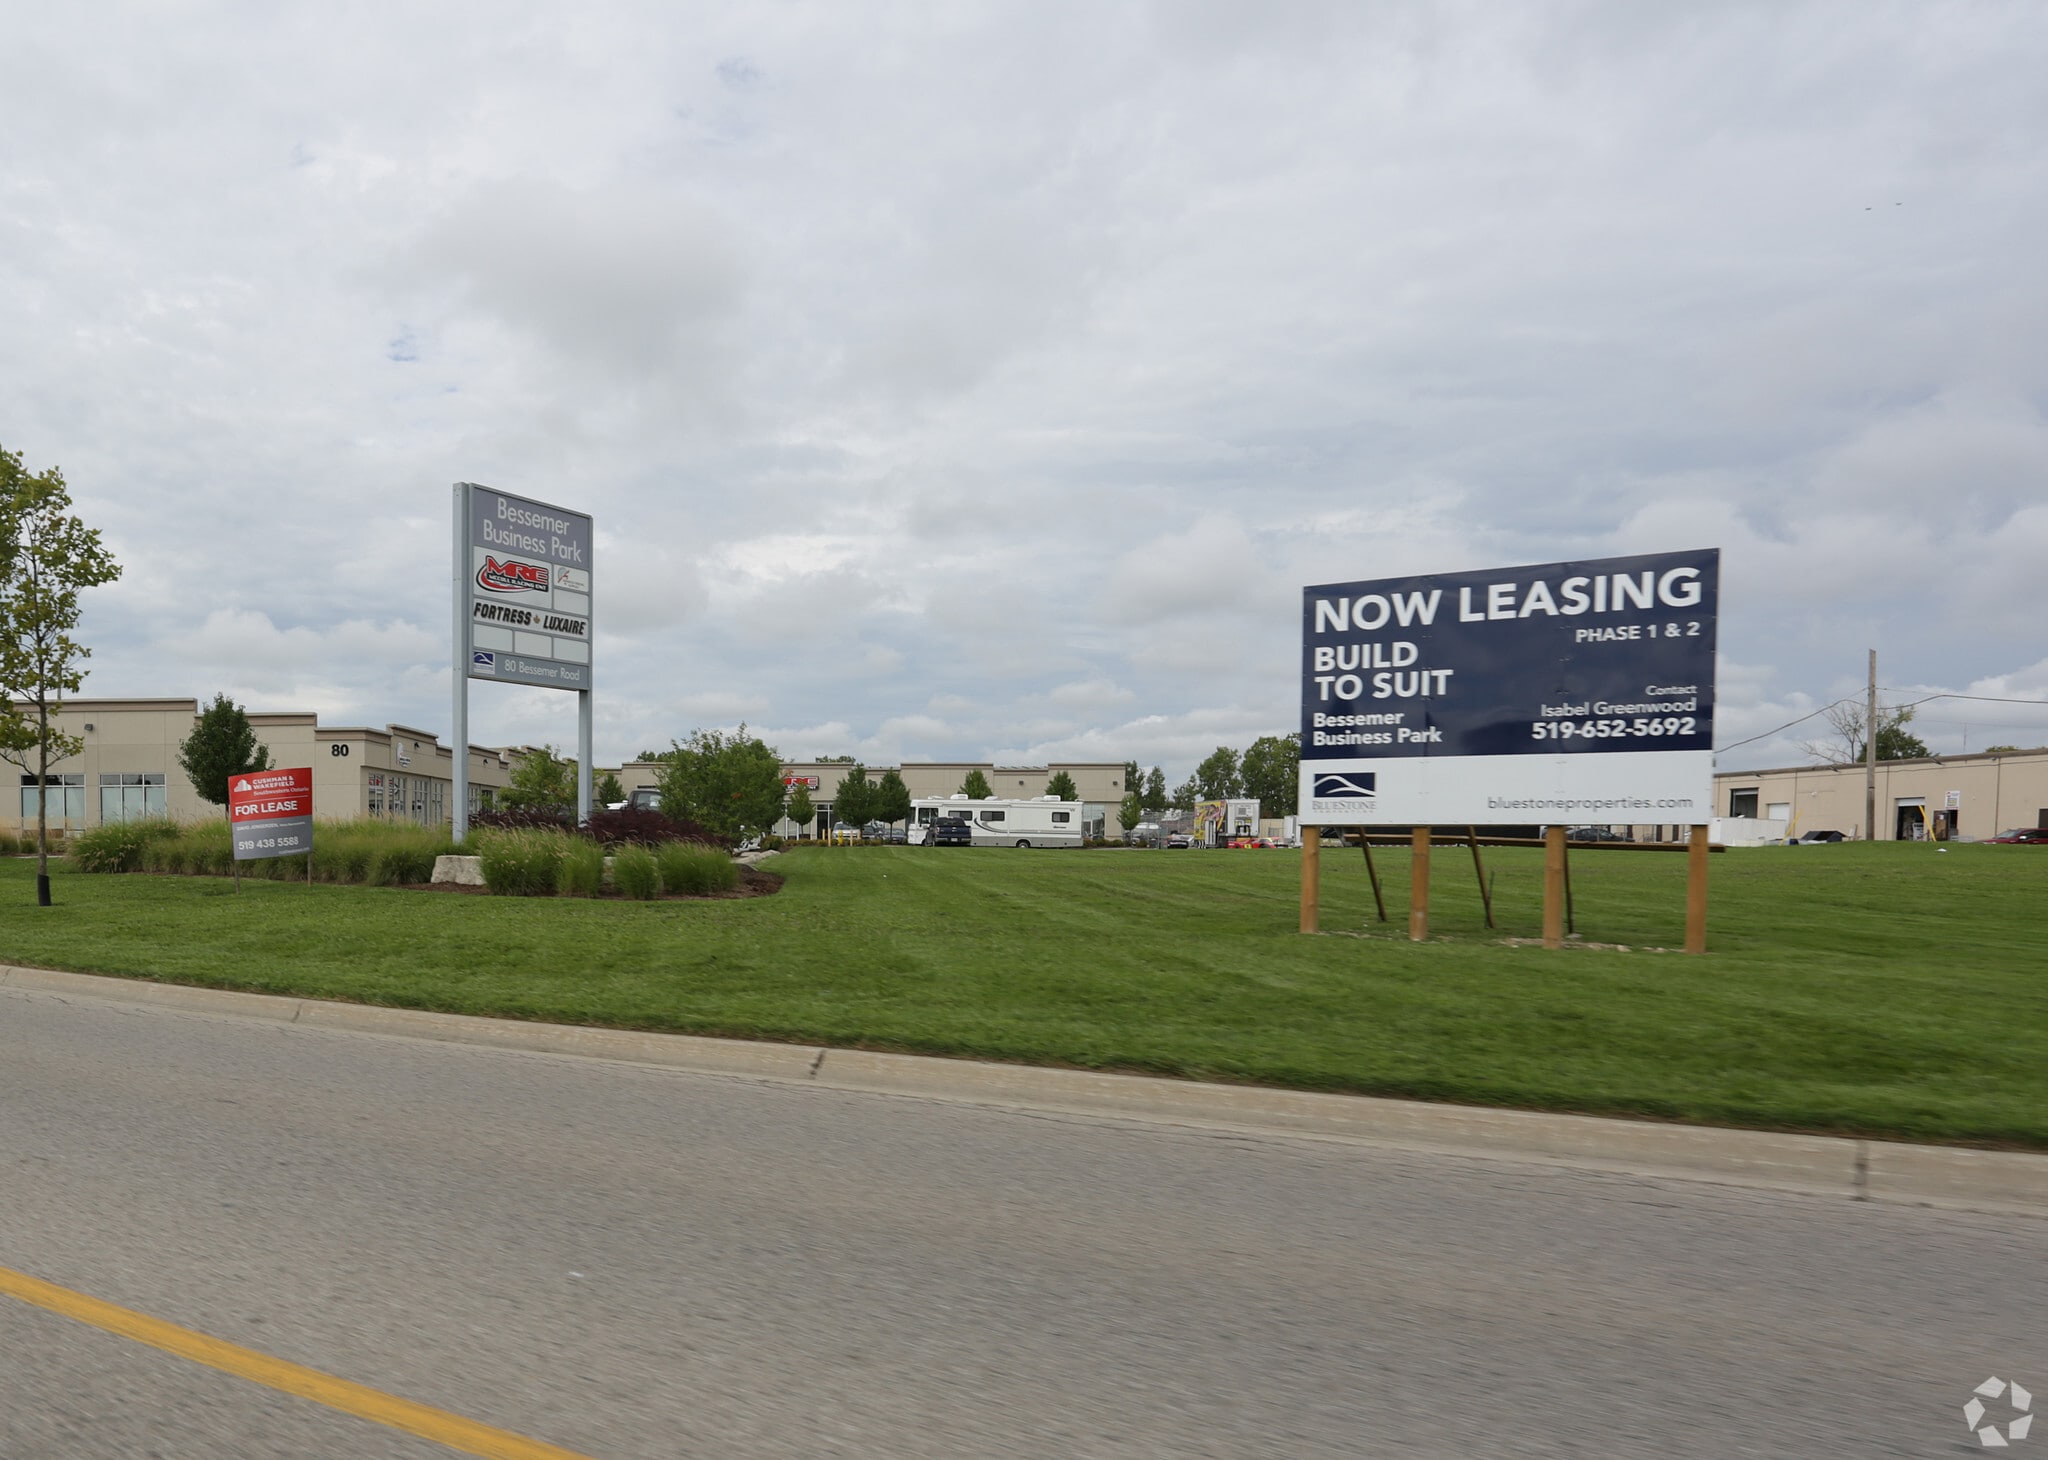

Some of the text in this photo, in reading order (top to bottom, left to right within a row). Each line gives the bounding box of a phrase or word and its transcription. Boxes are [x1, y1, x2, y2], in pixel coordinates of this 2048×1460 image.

[498, 498, 570, 535] Bessemer
[483, 520, 582, 563] Business Park
[486, 556, 549, 585] MRE
[512, 579, 535, 588] RACING
[535, 583, 547, 591] ENT
[1314, 567, 1701, 633] NOW LEASING
[473, 602, 532, 626] FORTRESS
[543, 614, 586, 635] LUXAIRE
[1575, 622, 1700, 643] PHASE 1 & 2
[1314, 641, 1418, 672] BUILD
[504, 659, 516, 672] 80
[519, 660, 558, 678] Bessemer
[560, 664, 580, 681] Road
[1314, 669, 1454, 701] TO SUIT
[1645, 684, 1698, 697] Contact
[1541, 697, 1697, 718] Isabel Greenwood
[1313, 711, 1405, 728] Bessemer
[1532, 717, 1696, 741] 519-652-5692
[1313, 727, 1443, 747] Business Park
[331, 744, 349, 757] 80
[252, 776, 288, 785] CUSHMAN
[252, 780, 295, 790] WAKEFIELD
[235, 800, 298, 817] FOR LEASE
[1488, 796, 1693, 812] bluestoneproperties.com
[238, 840, 255, 850] 519
[256, 838, 276, 849] 438
